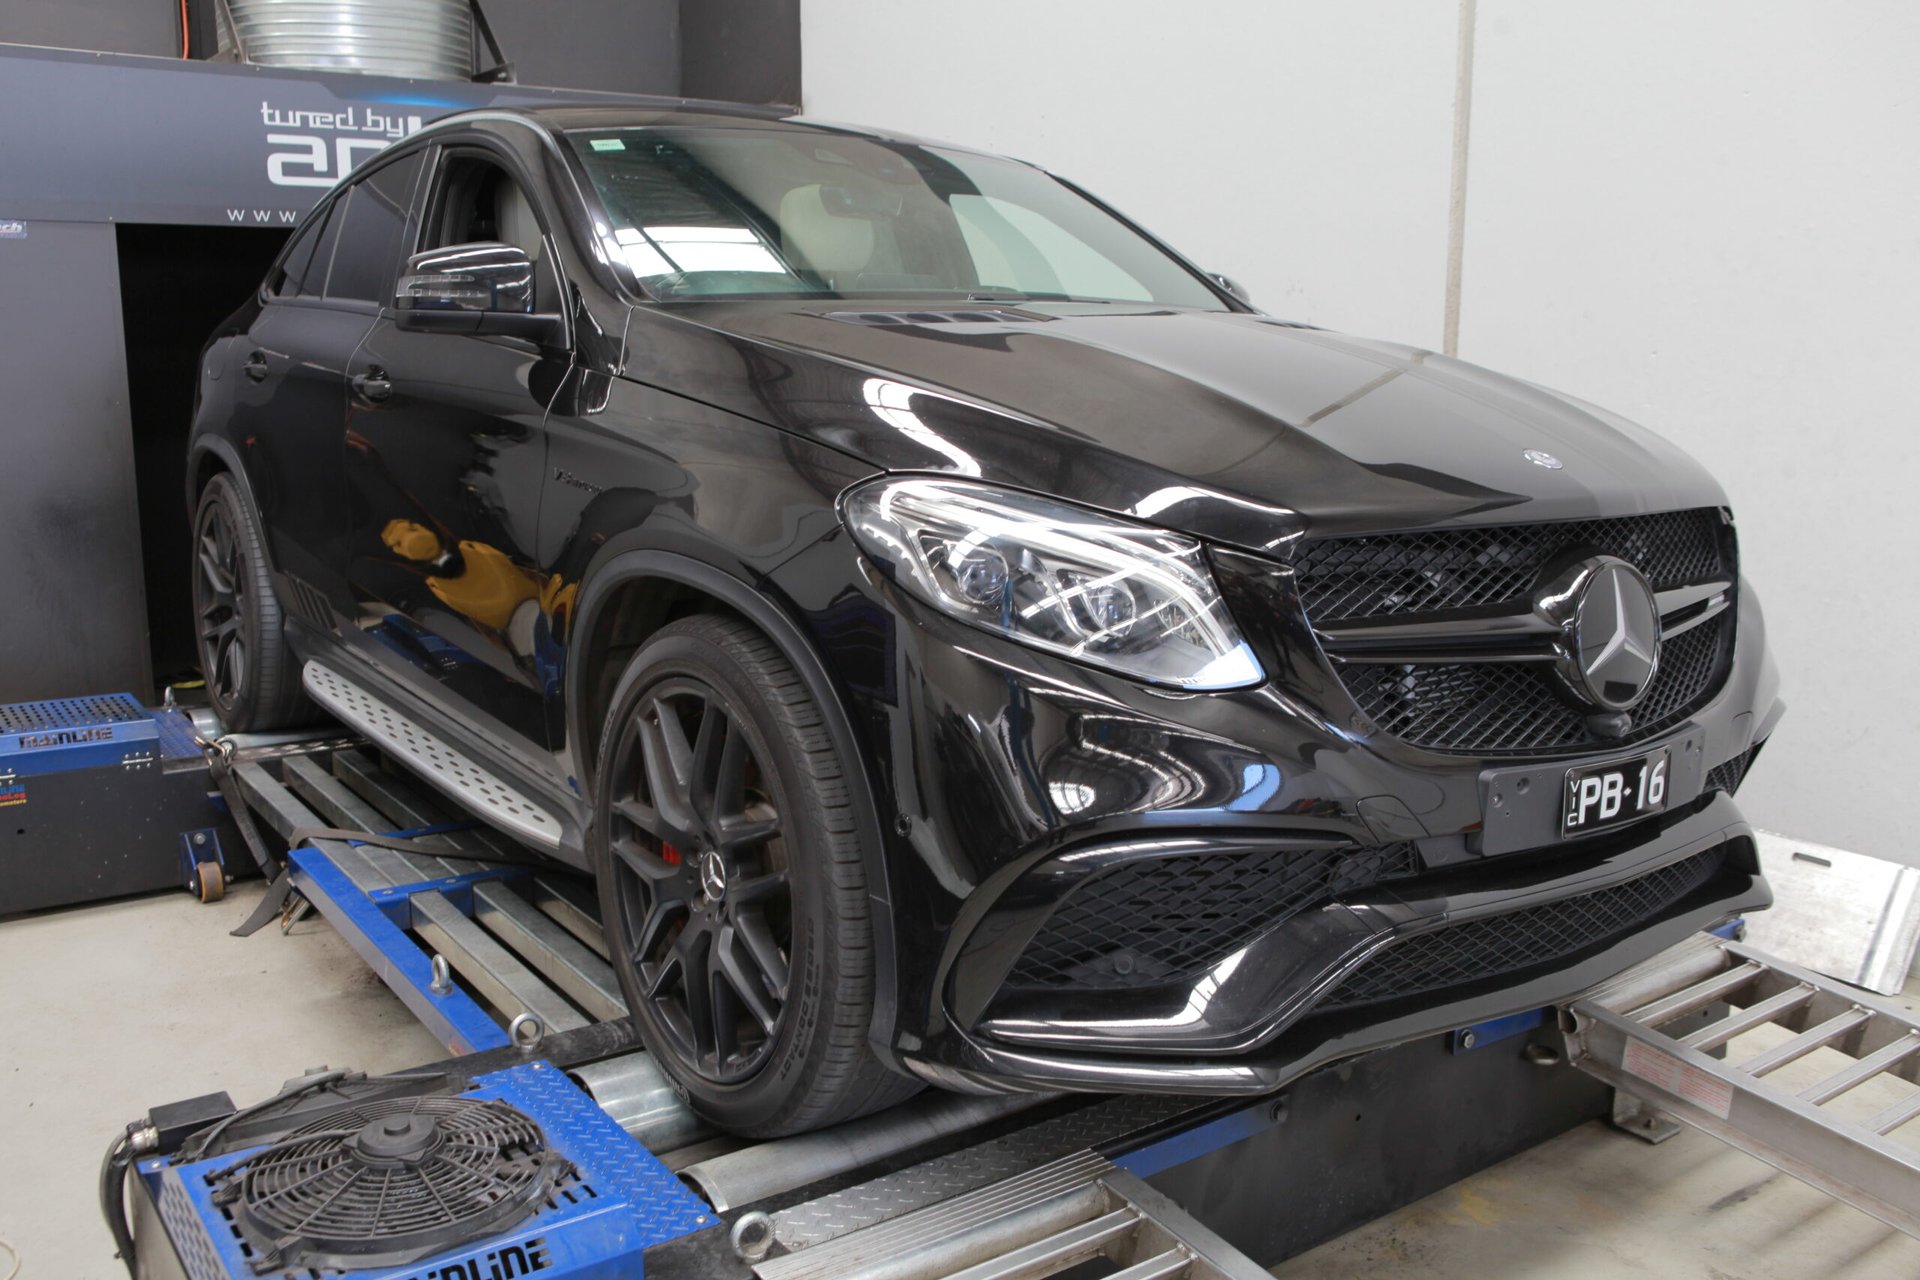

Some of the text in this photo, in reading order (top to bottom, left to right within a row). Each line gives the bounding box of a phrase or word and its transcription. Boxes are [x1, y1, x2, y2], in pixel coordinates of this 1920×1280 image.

[261, 101, 404, 137] tuned by
[19, 727, 113, 748] MAINLINE
[1567, 780, 1580, 827] VIC
